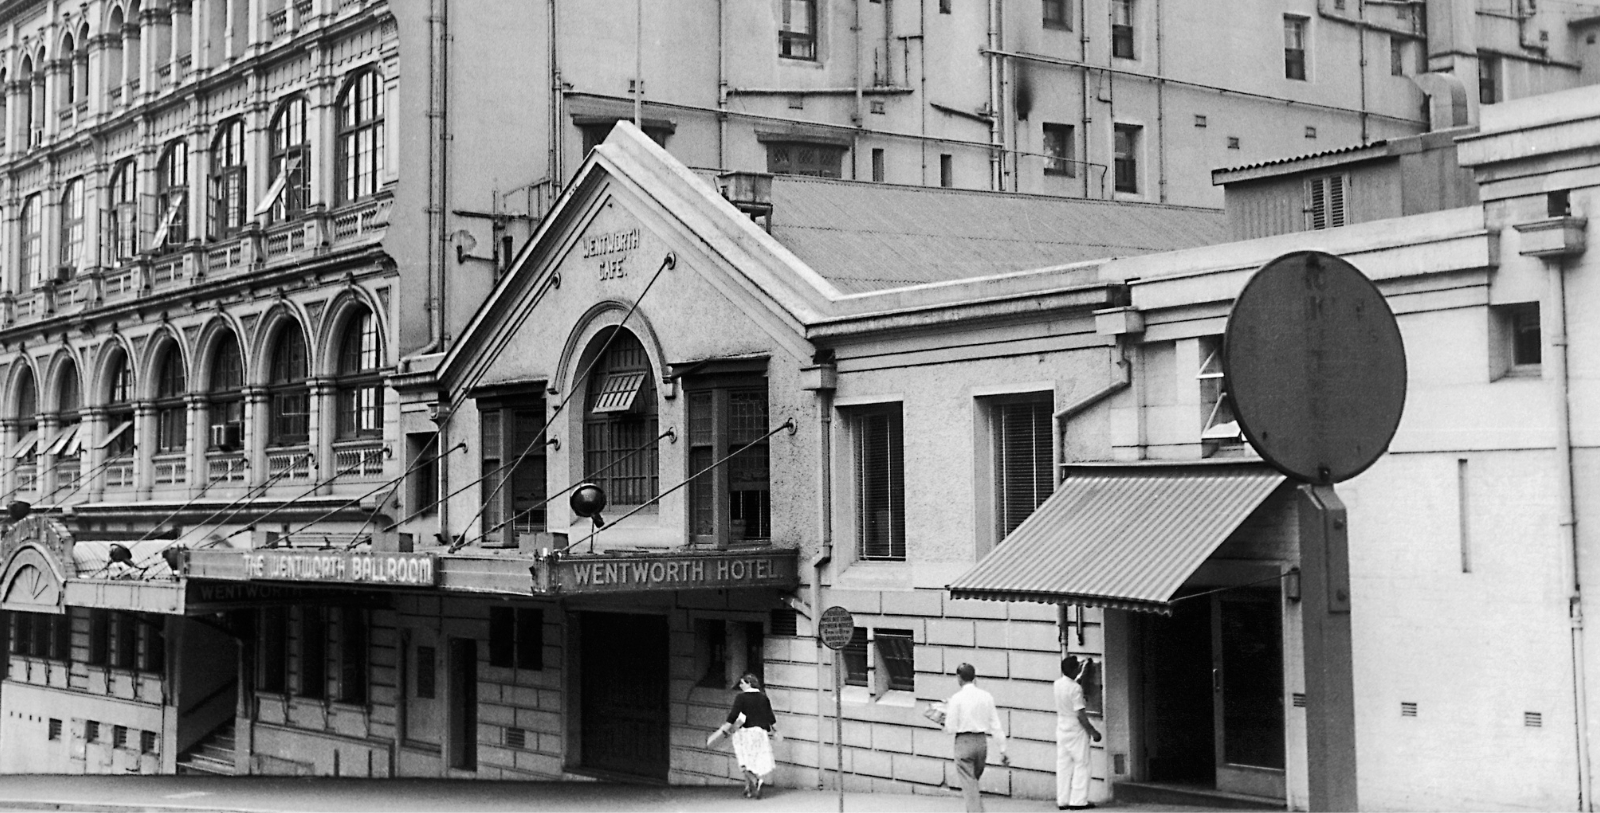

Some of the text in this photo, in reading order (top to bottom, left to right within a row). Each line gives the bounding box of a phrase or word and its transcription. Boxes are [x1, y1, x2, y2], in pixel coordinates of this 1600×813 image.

[583, 228, 640, 259] WENTWORTH
[244, 554, 431, 583] THE WENTWORTH BALLROOM
[573, 561, 704, 585] WENTWORTH
